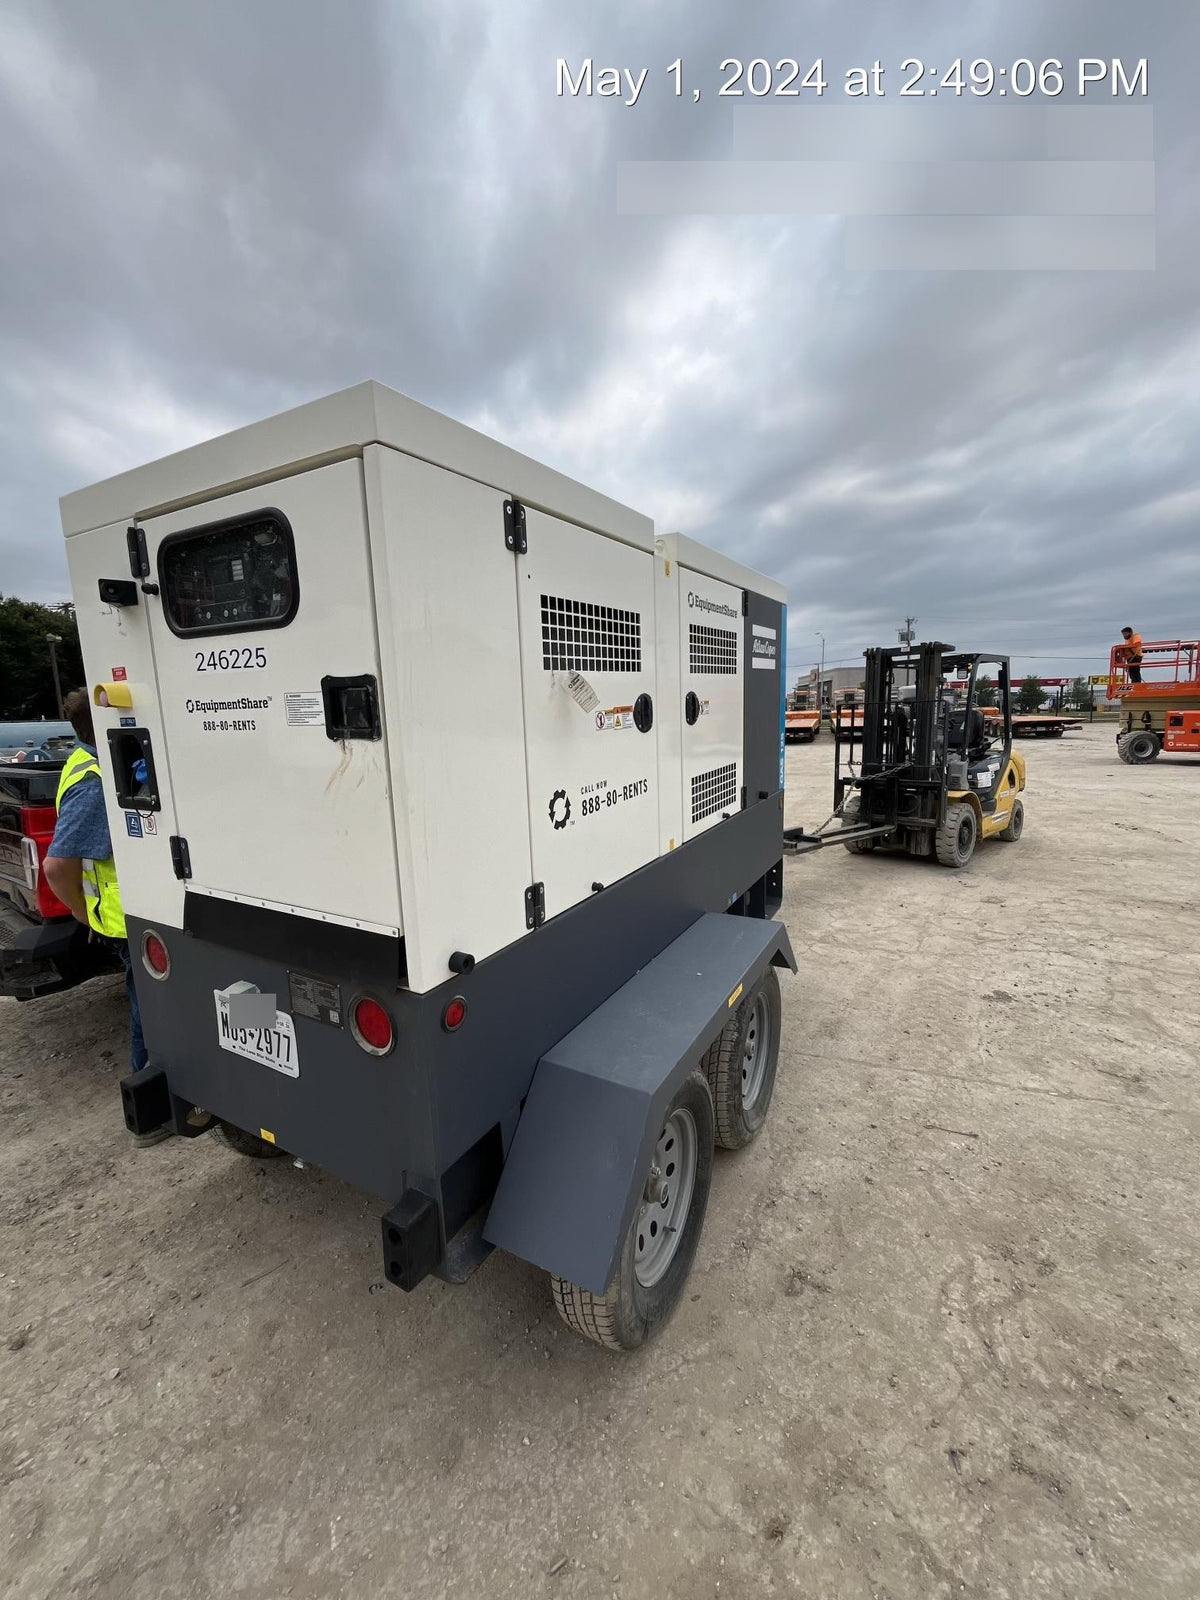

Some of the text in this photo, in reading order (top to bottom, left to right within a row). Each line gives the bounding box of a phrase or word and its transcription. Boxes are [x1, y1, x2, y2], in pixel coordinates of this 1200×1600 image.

[695, 595, 738, 619] EquipmentShare
[195, 647, 267, 672] 246225
[195, 697, 269, 714] EquipmentShare
[203, 720, 257, 732] 888-80-RENTS
[581, 779, 608, 795] CALL NOW
[581, 778, 648, 817] 888-80-RENTS
